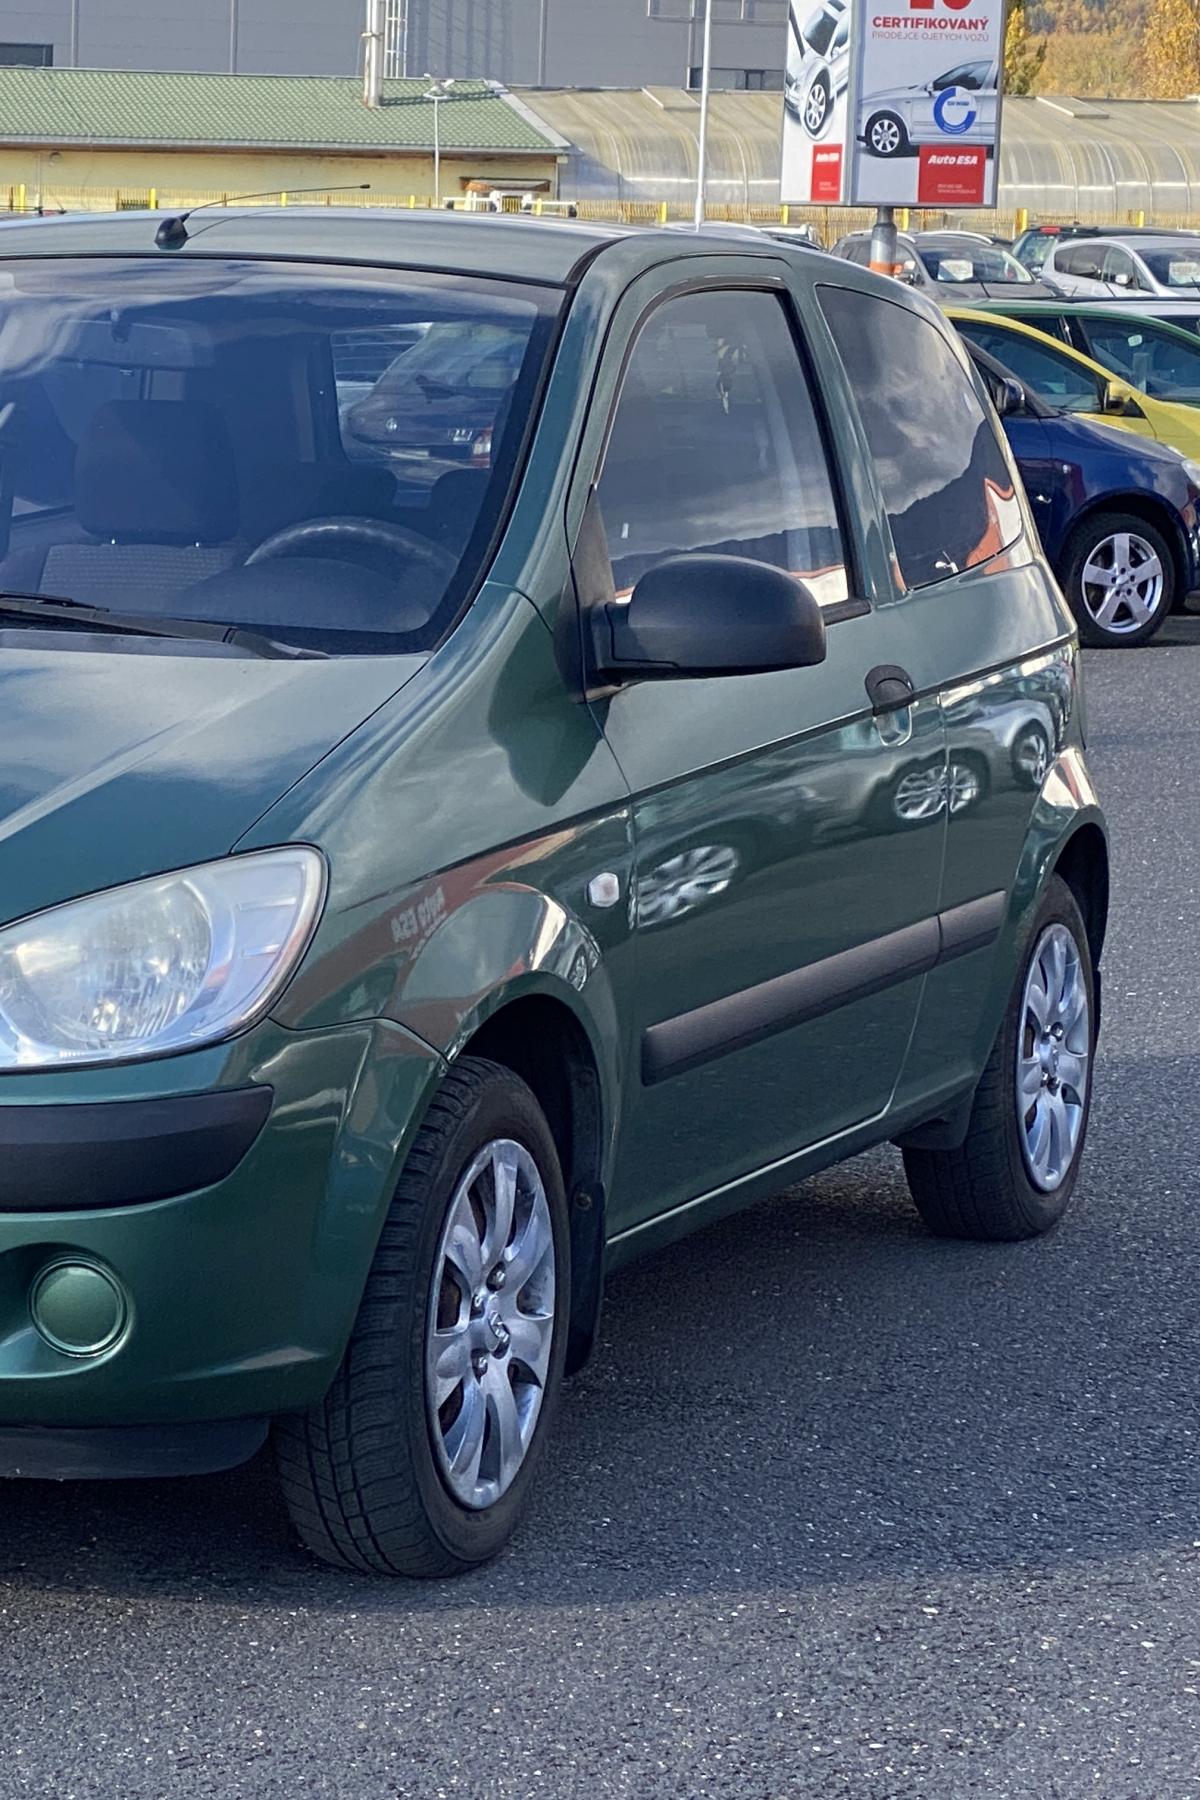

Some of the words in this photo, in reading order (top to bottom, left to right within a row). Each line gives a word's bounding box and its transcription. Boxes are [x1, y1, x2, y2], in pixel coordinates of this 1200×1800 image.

[872, 16, 990, 31] CERTIFIKOVANÝ
[871, 31, 920, 41] PRODEJCE
[921, 31, 962, 42] OJETÝCH
[927, 154, 956, 165] Auto
[956, 154, 978, 165] ESA
